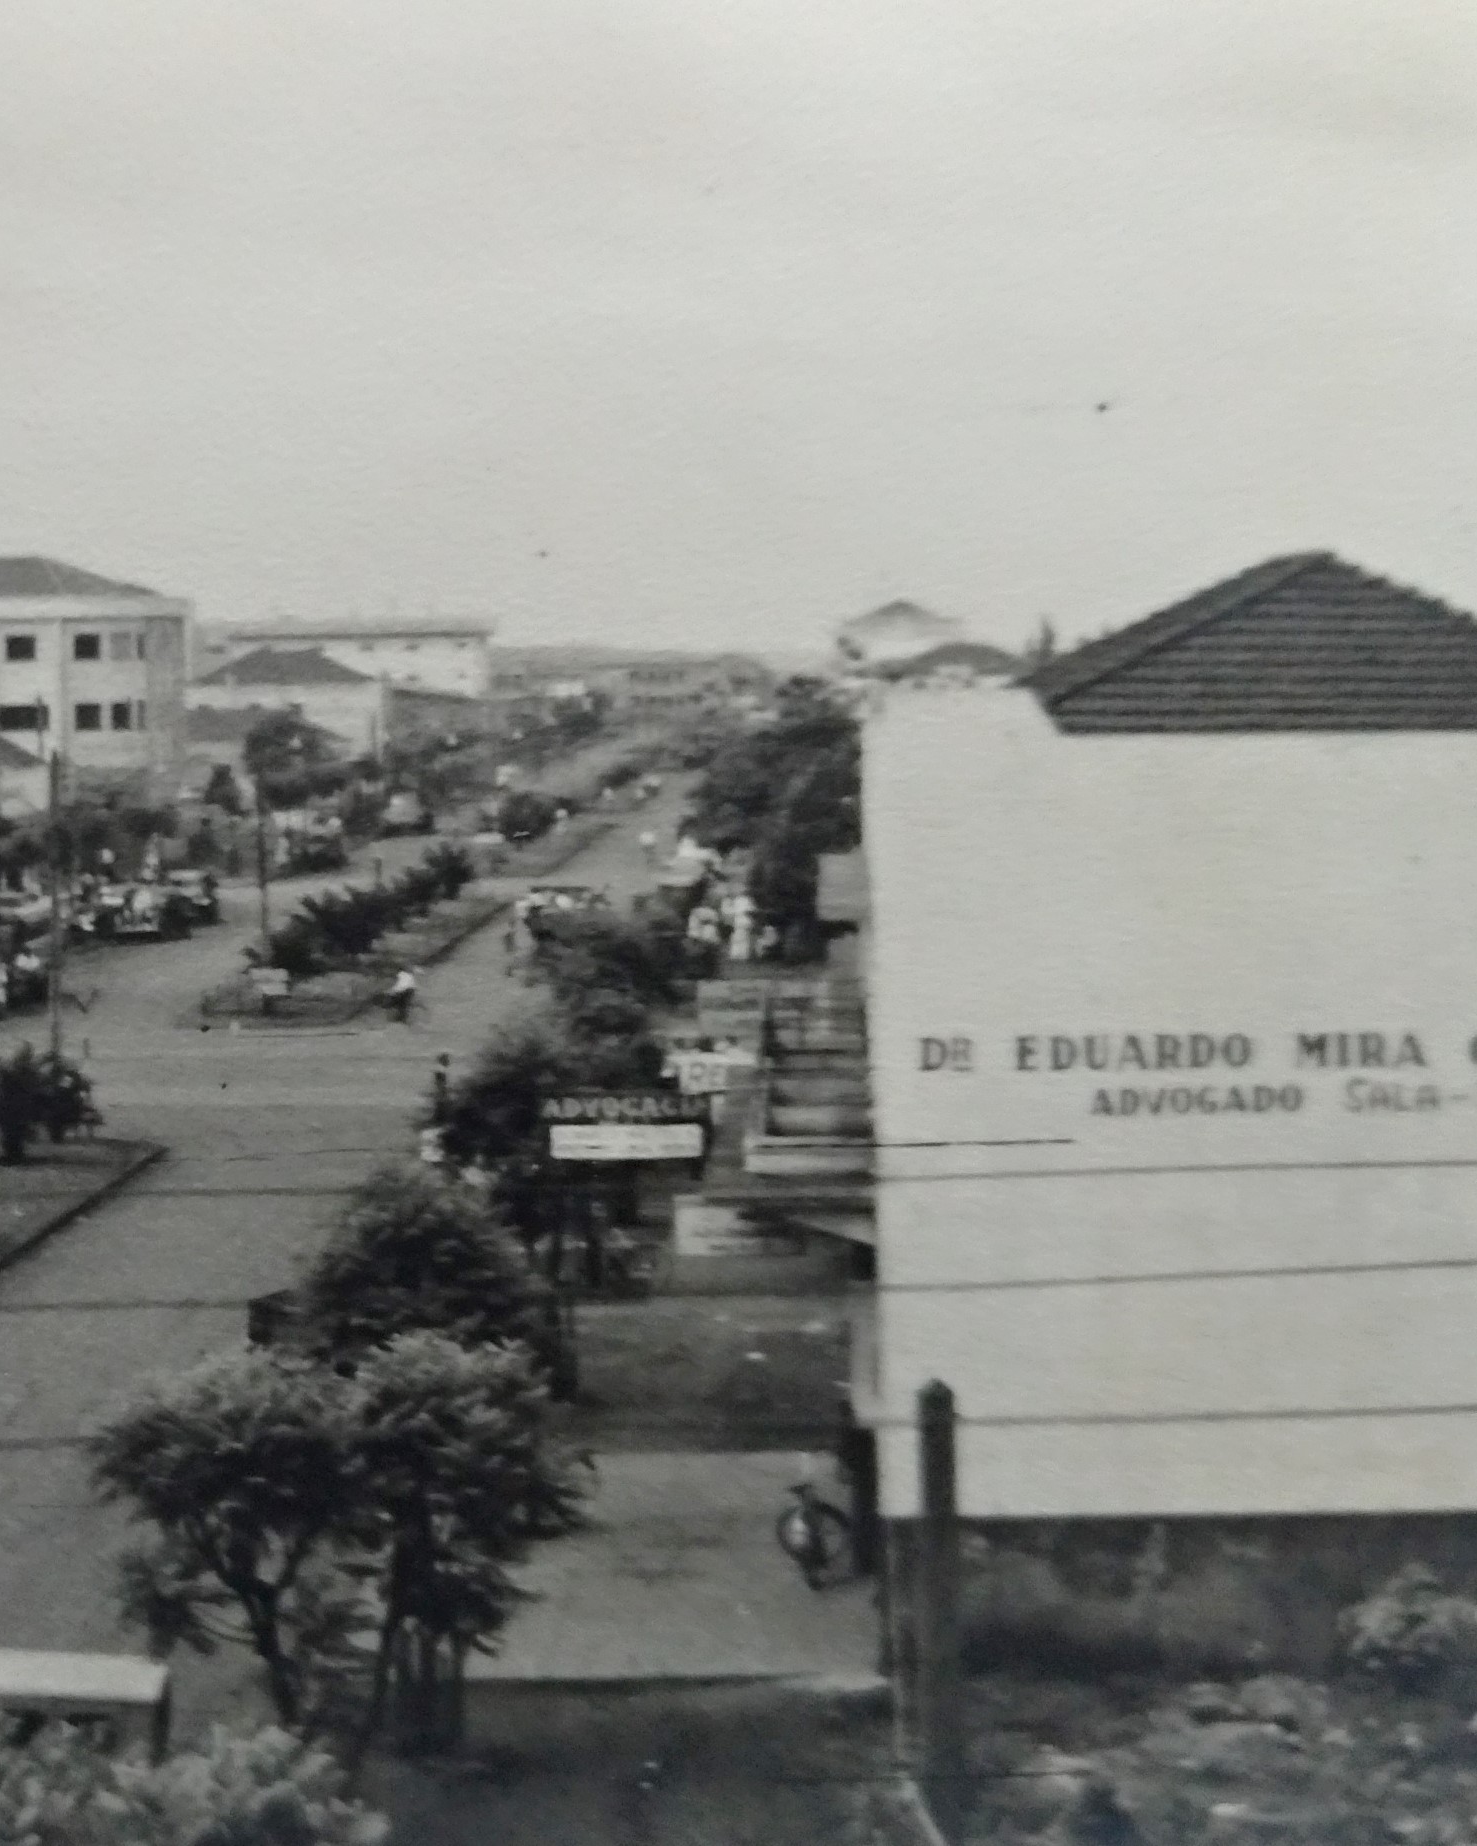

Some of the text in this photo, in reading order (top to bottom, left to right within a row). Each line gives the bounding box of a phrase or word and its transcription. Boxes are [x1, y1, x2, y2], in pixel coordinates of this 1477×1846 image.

[1016, 1034, 1252, 1071] EDUARDO
[1297, 1033, 1426, 1067] MIRA
[1092, 1086, 1303, 1115] ADVOGADO
